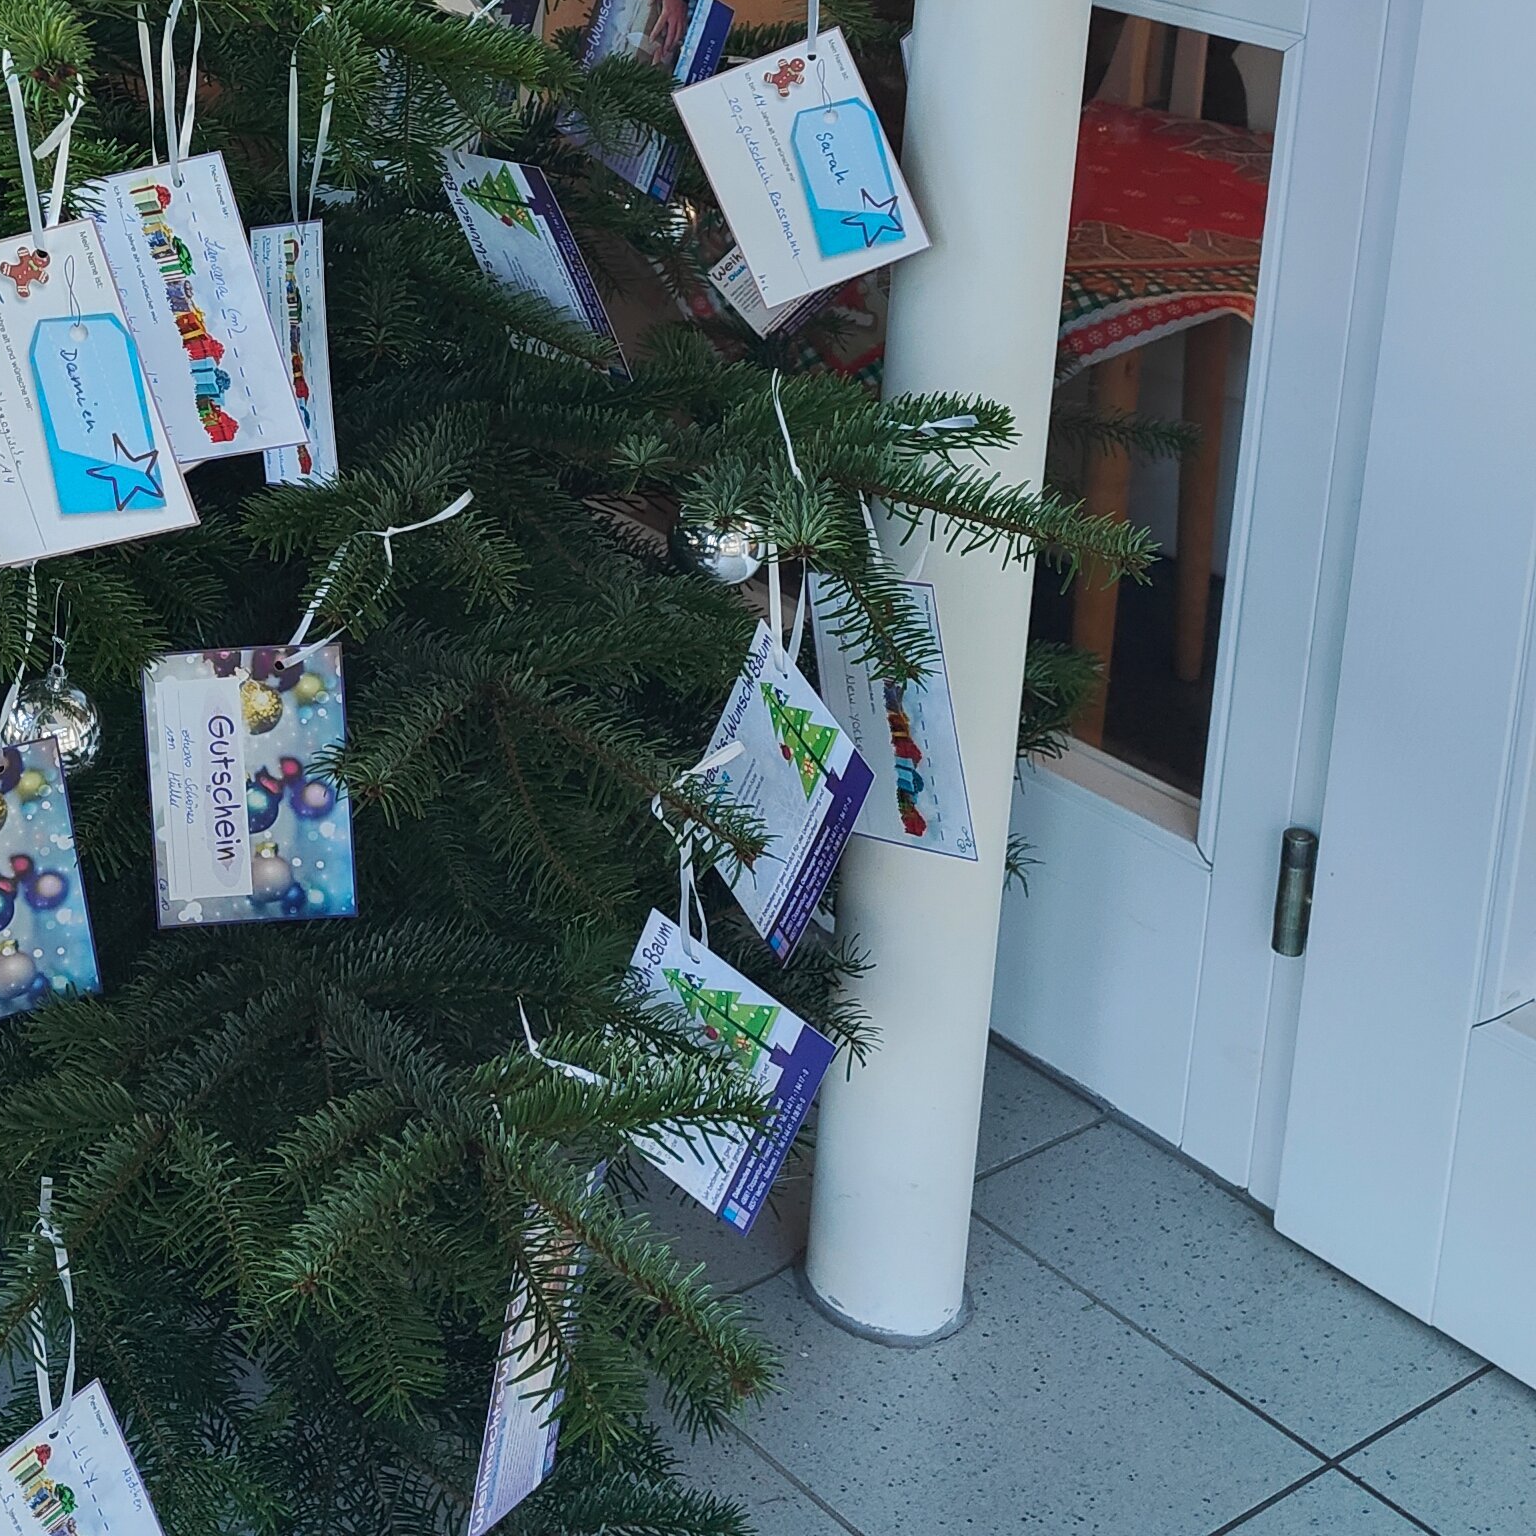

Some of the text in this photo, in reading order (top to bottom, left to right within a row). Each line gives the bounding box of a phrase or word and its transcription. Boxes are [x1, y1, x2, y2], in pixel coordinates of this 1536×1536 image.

[815, 131, 849, 185] Sarah
[77, 231, 105, 288] Mein Name ist:
[201, 235, 247, 335] Lansana (m)
[0, 332, 11, 344] alt
[4, 343, 17, 361] und
[9, 360, 29, 396] wünsche
[22, 396, 34, 412] mir:
[57, 346, 102, 434] Damien
[207, 714, 241, 860] Gutschein
